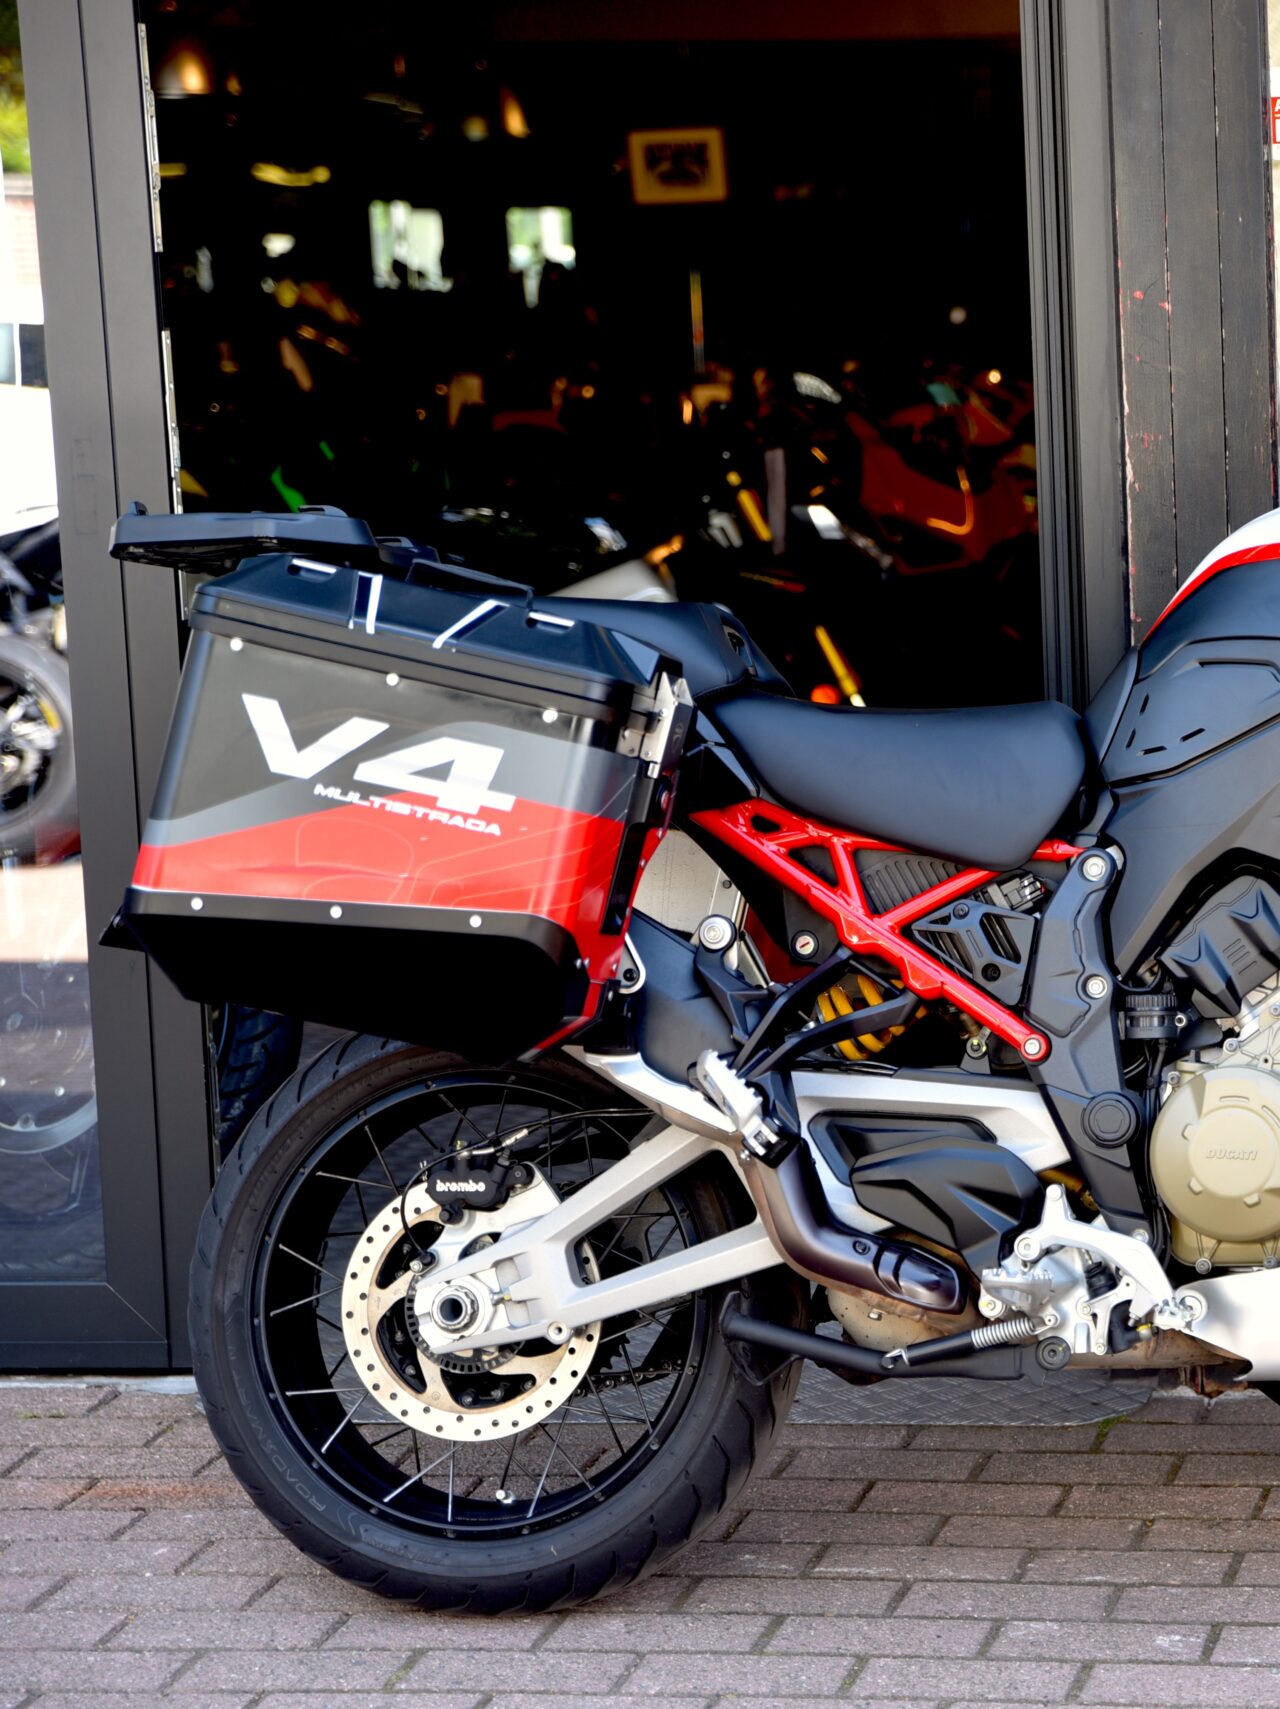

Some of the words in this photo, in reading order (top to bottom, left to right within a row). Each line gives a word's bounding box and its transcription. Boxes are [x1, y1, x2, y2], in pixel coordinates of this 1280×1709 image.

[241, 692, 517, 816] V4
[313, 783, 502, 837] MULTISTRADA
[1205, 1147, 1258, 1161] DUCATI
[436, 1178, 486, 1192] brembo
